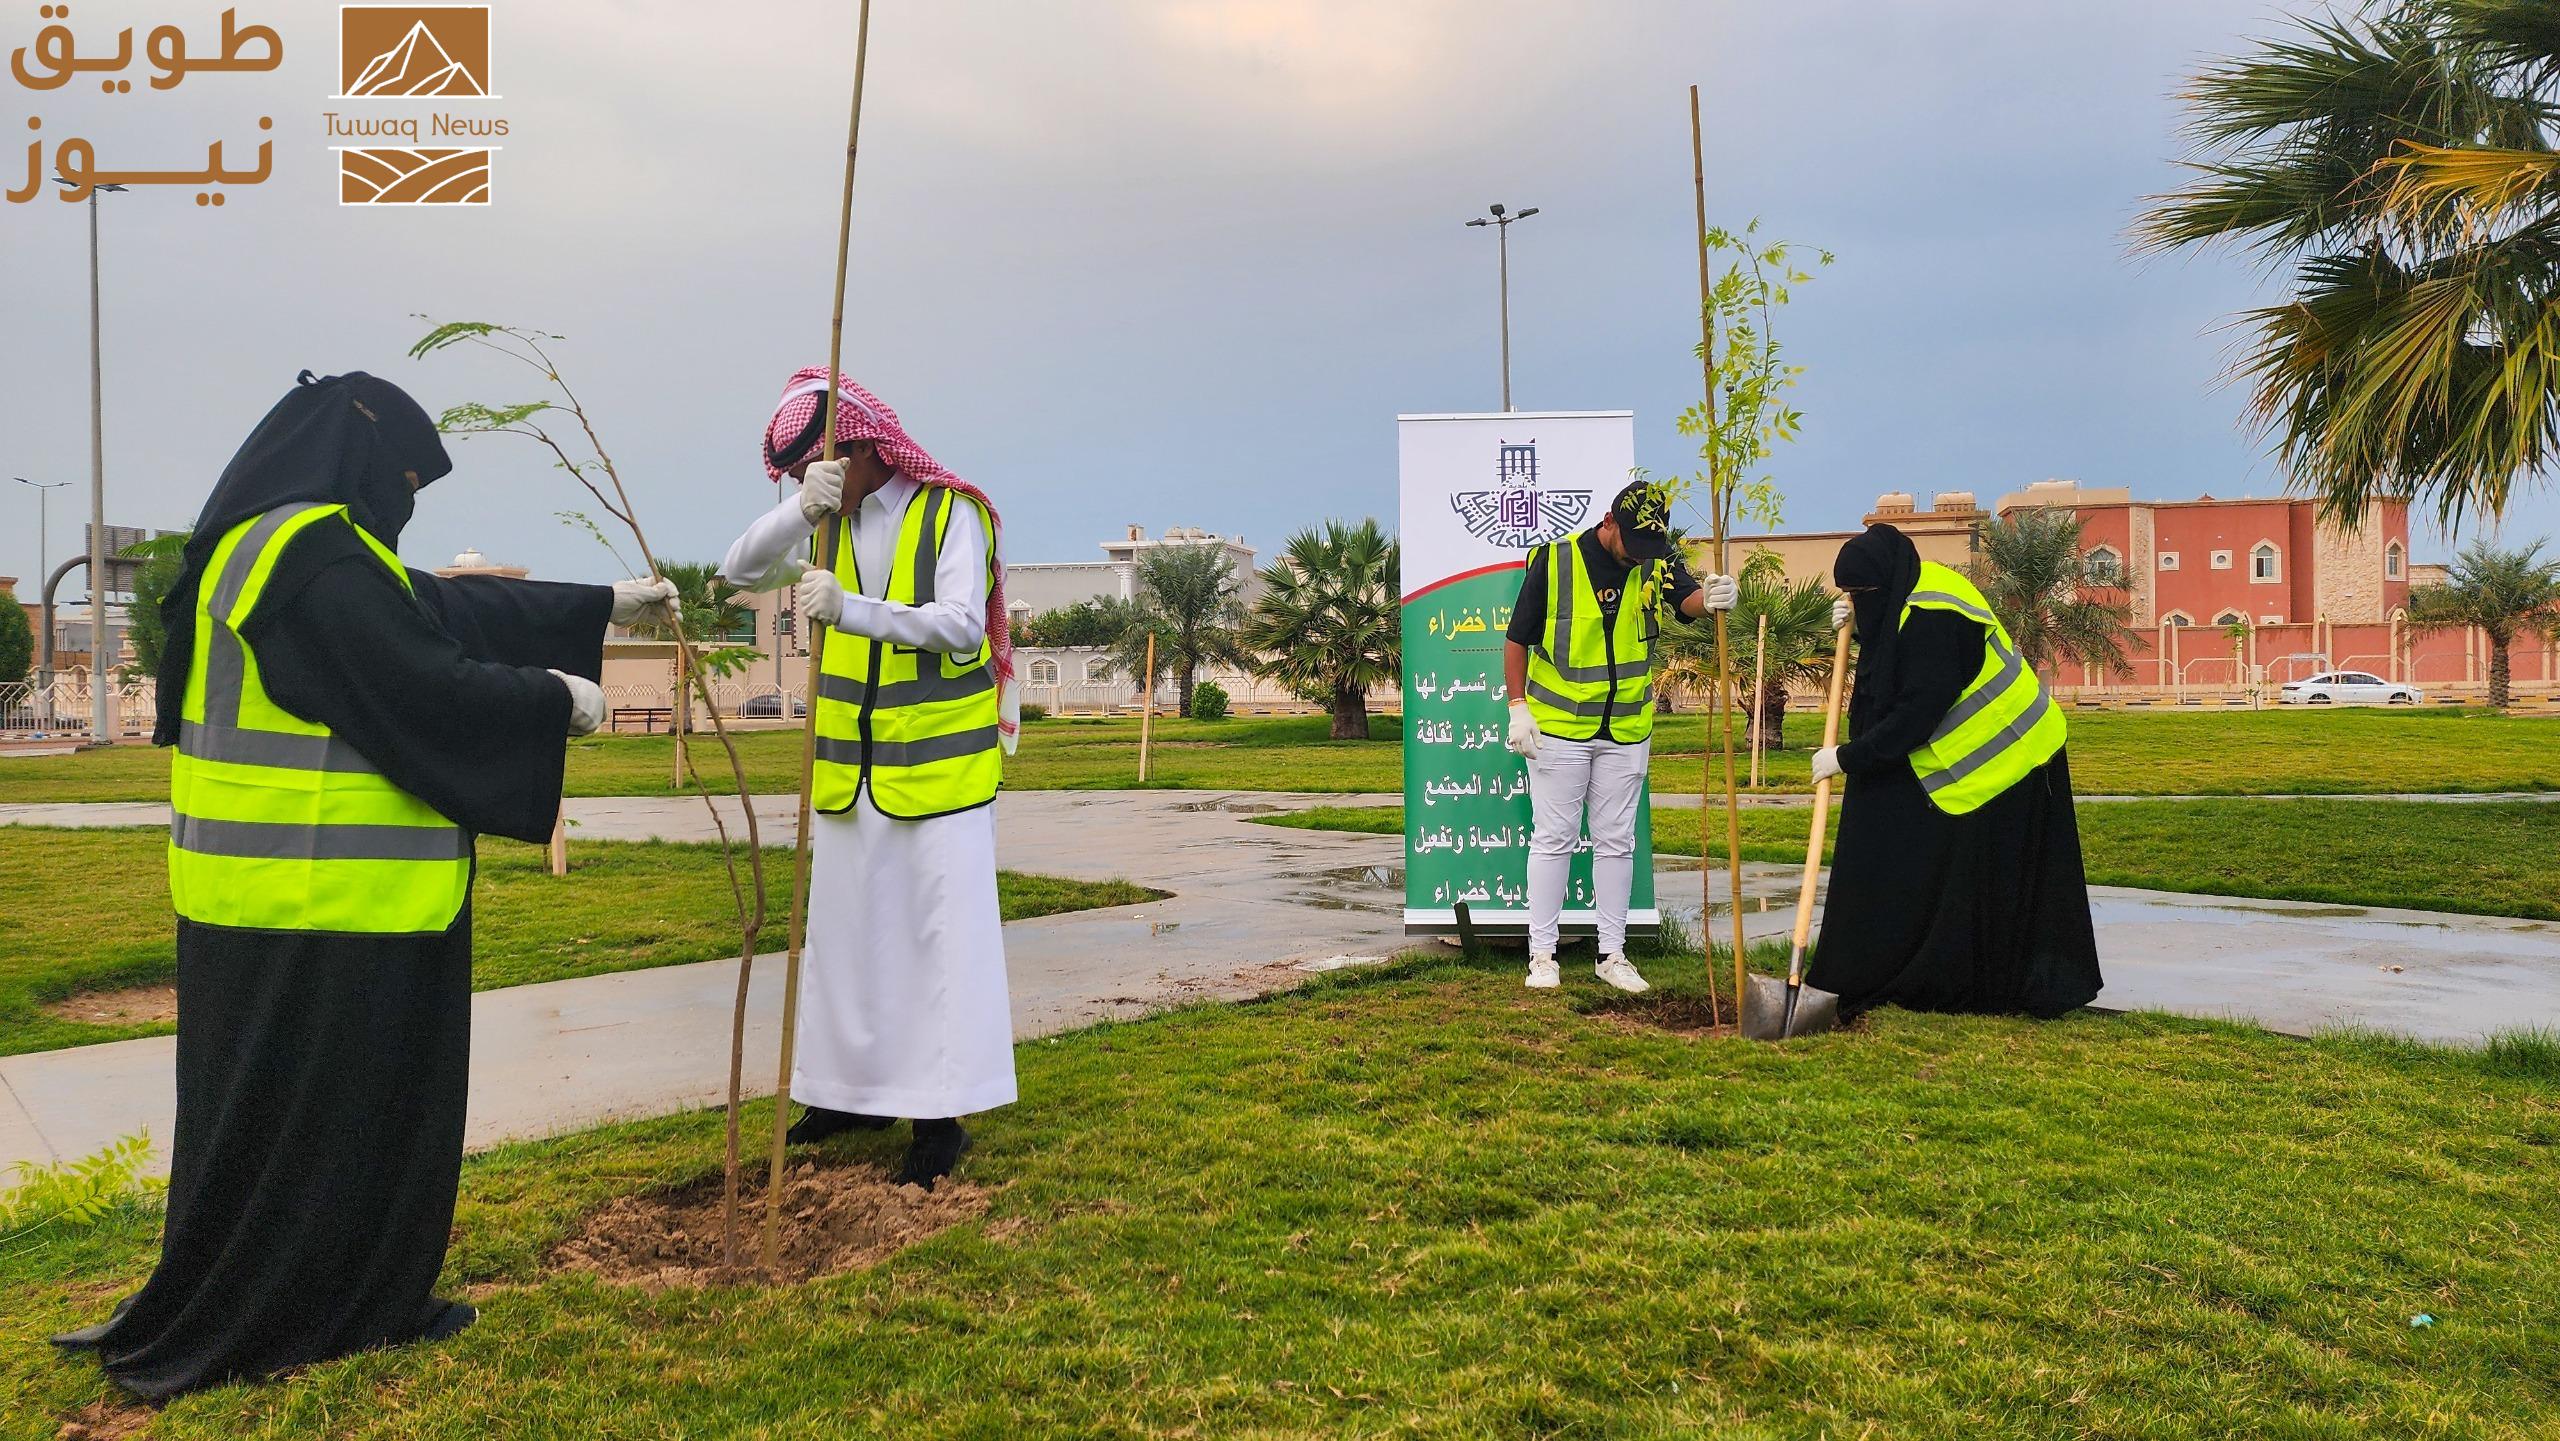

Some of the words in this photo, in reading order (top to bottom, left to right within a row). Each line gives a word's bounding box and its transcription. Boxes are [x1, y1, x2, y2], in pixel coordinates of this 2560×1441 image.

[1428, 607, 1487, 641] خضراء
[1414, 671, 1437, 700] لها
[1441, 672, 1487, 702] تسعى
[1416, 719, 1453, 744] ثقافة
[1458, 723, 1499, 750] تعزيز
[1424, 773, 1482, 807] المجتمع
[1414, 824, 1464, 855] وتفعيل
[1469, 825, 1512, 854] الحياة
[1435, 879, 1491, 908] خضراء
